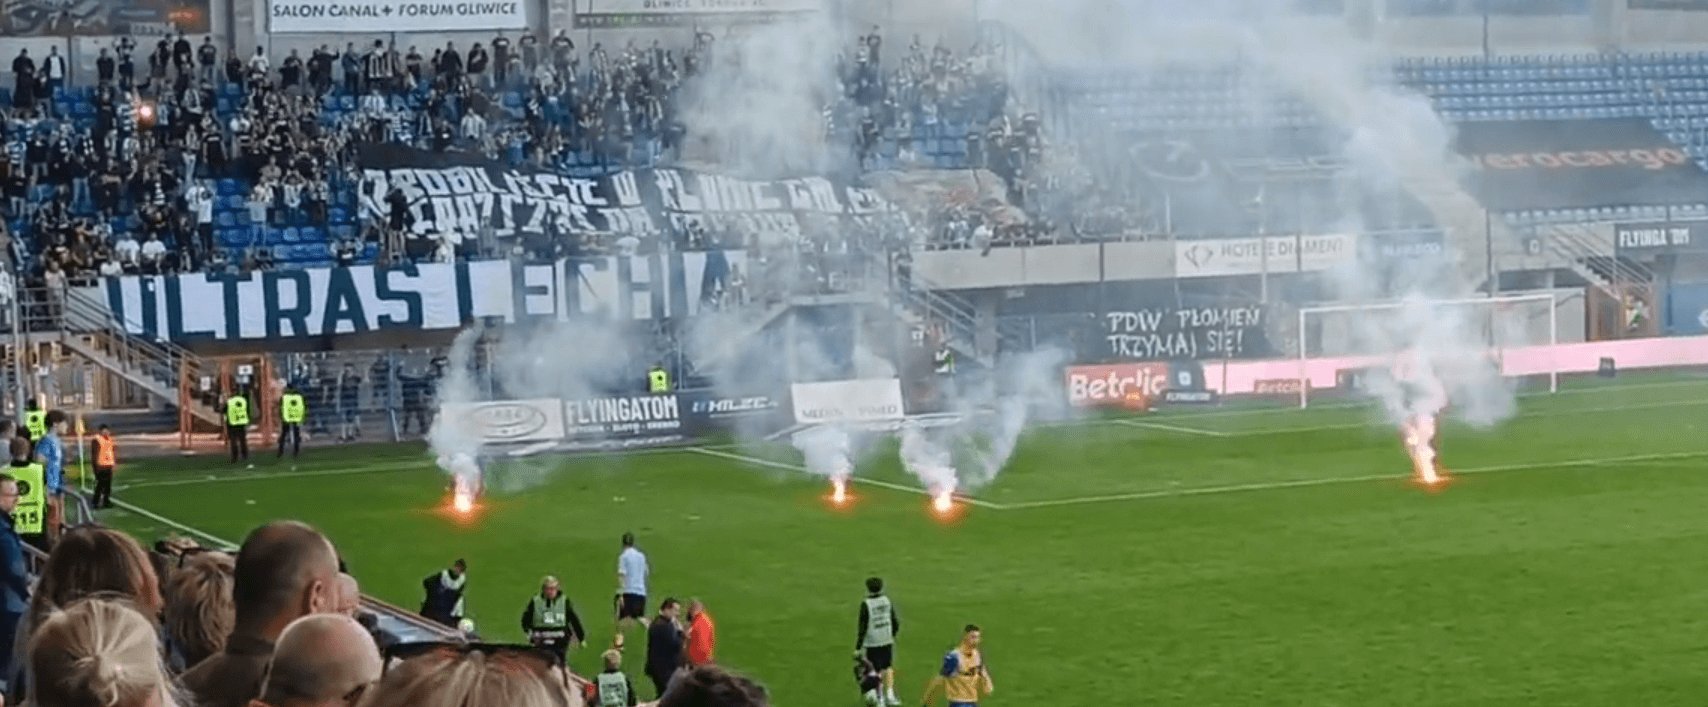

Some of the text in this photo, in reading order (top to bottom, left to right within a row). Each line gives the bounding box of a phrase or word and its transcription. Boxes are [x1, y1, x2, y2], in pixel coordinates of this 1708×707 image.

[273, 2, 517, 17] SALON CANAL + FORUM GLIWICE
[1221, 241, 1276, 258] HOTEE
[104, 263, 424, 340] ULTRAS
[566, 395, 679, 424] FLYINGATOM
